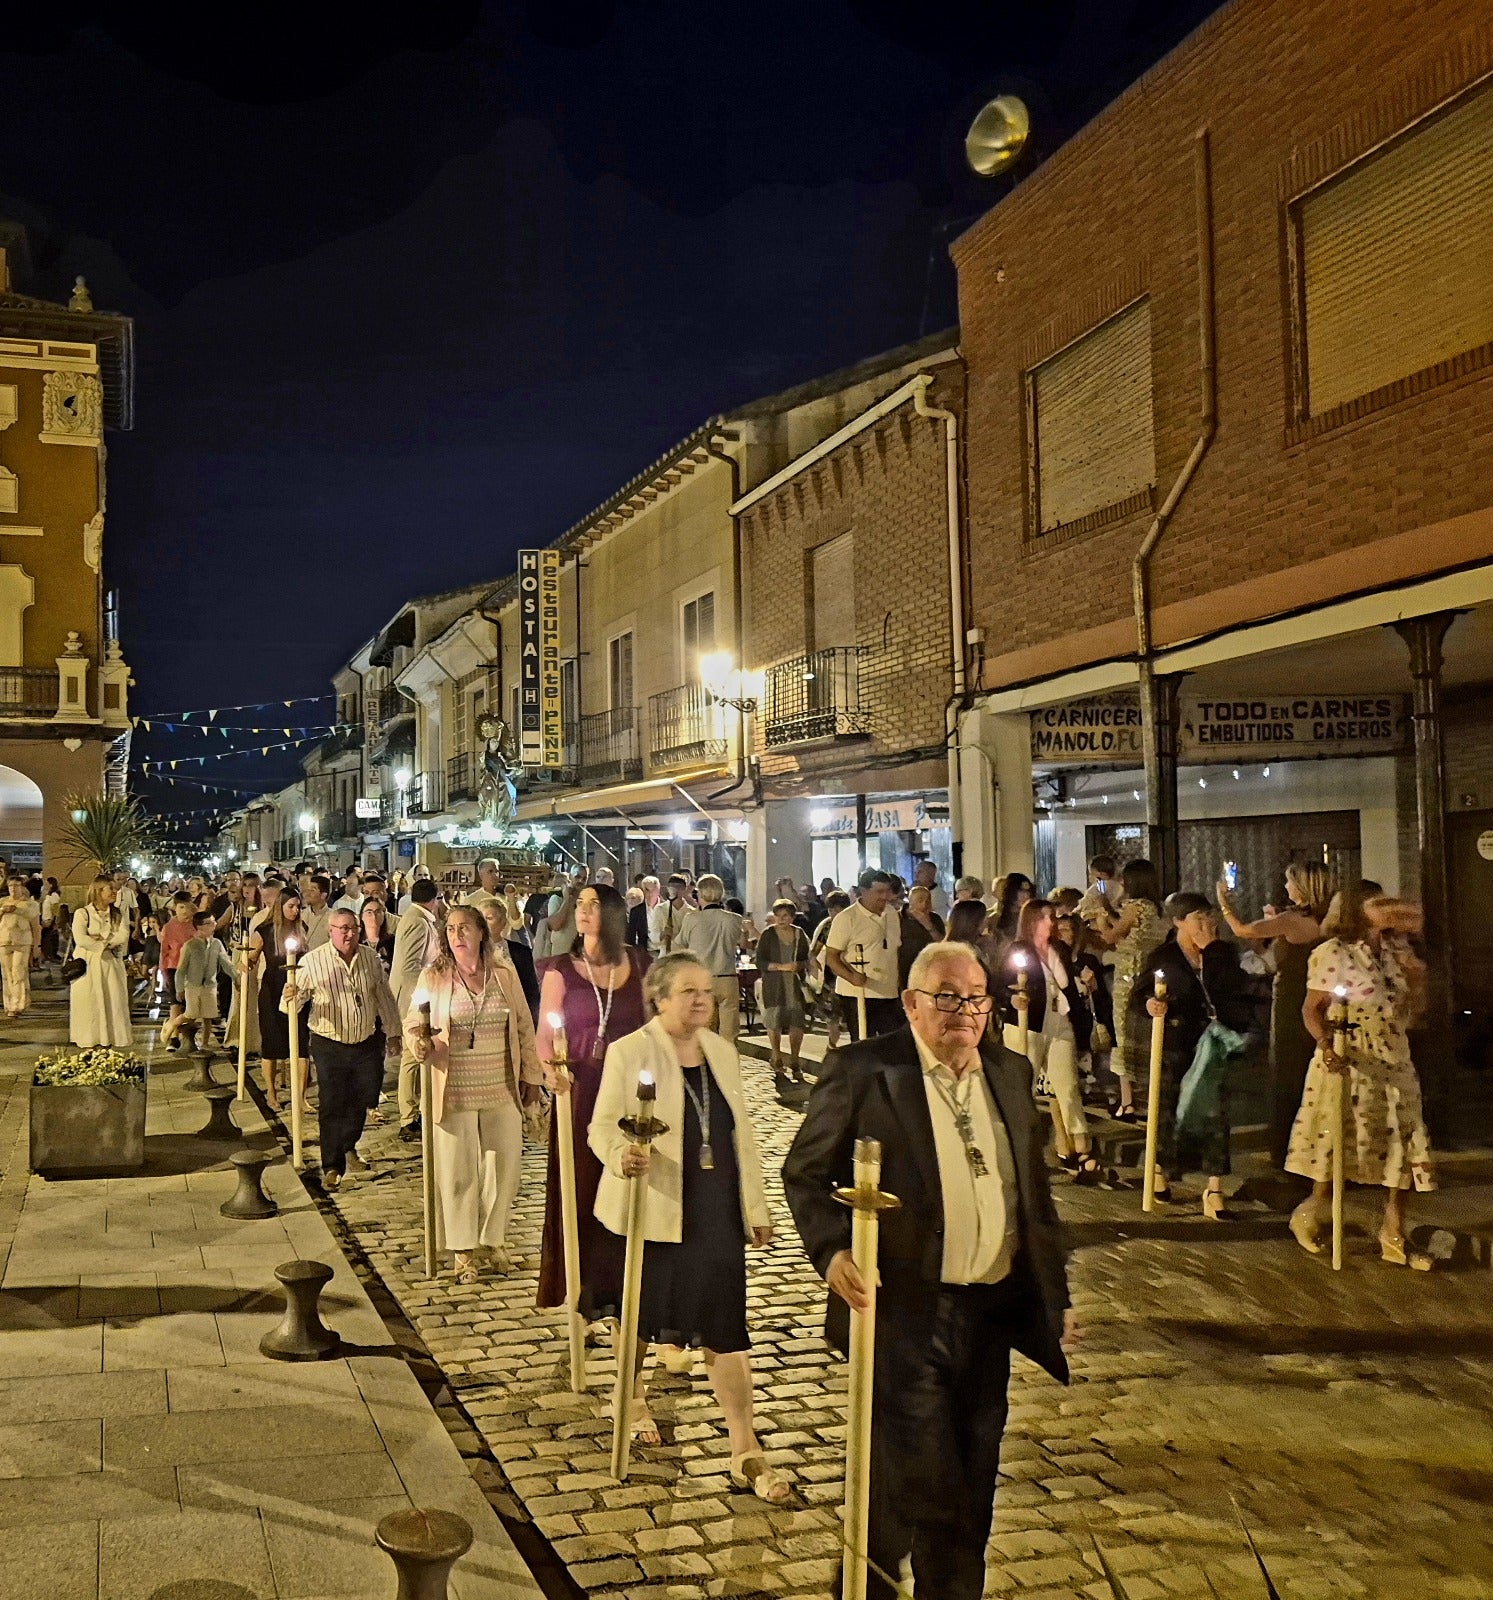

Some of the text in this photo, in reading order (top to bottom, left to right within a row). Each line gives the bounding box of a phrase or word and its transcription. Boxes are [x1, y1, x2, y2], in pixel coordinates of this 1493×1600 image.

[521, 555, 538, 680] HOSTAL
[543, 552, 558, 699] restaurante
[1197, 700, 1391, 721] TODO EN CARNES
[1198, 720, 1392, 743] EMBUTIDOS CASEROS
